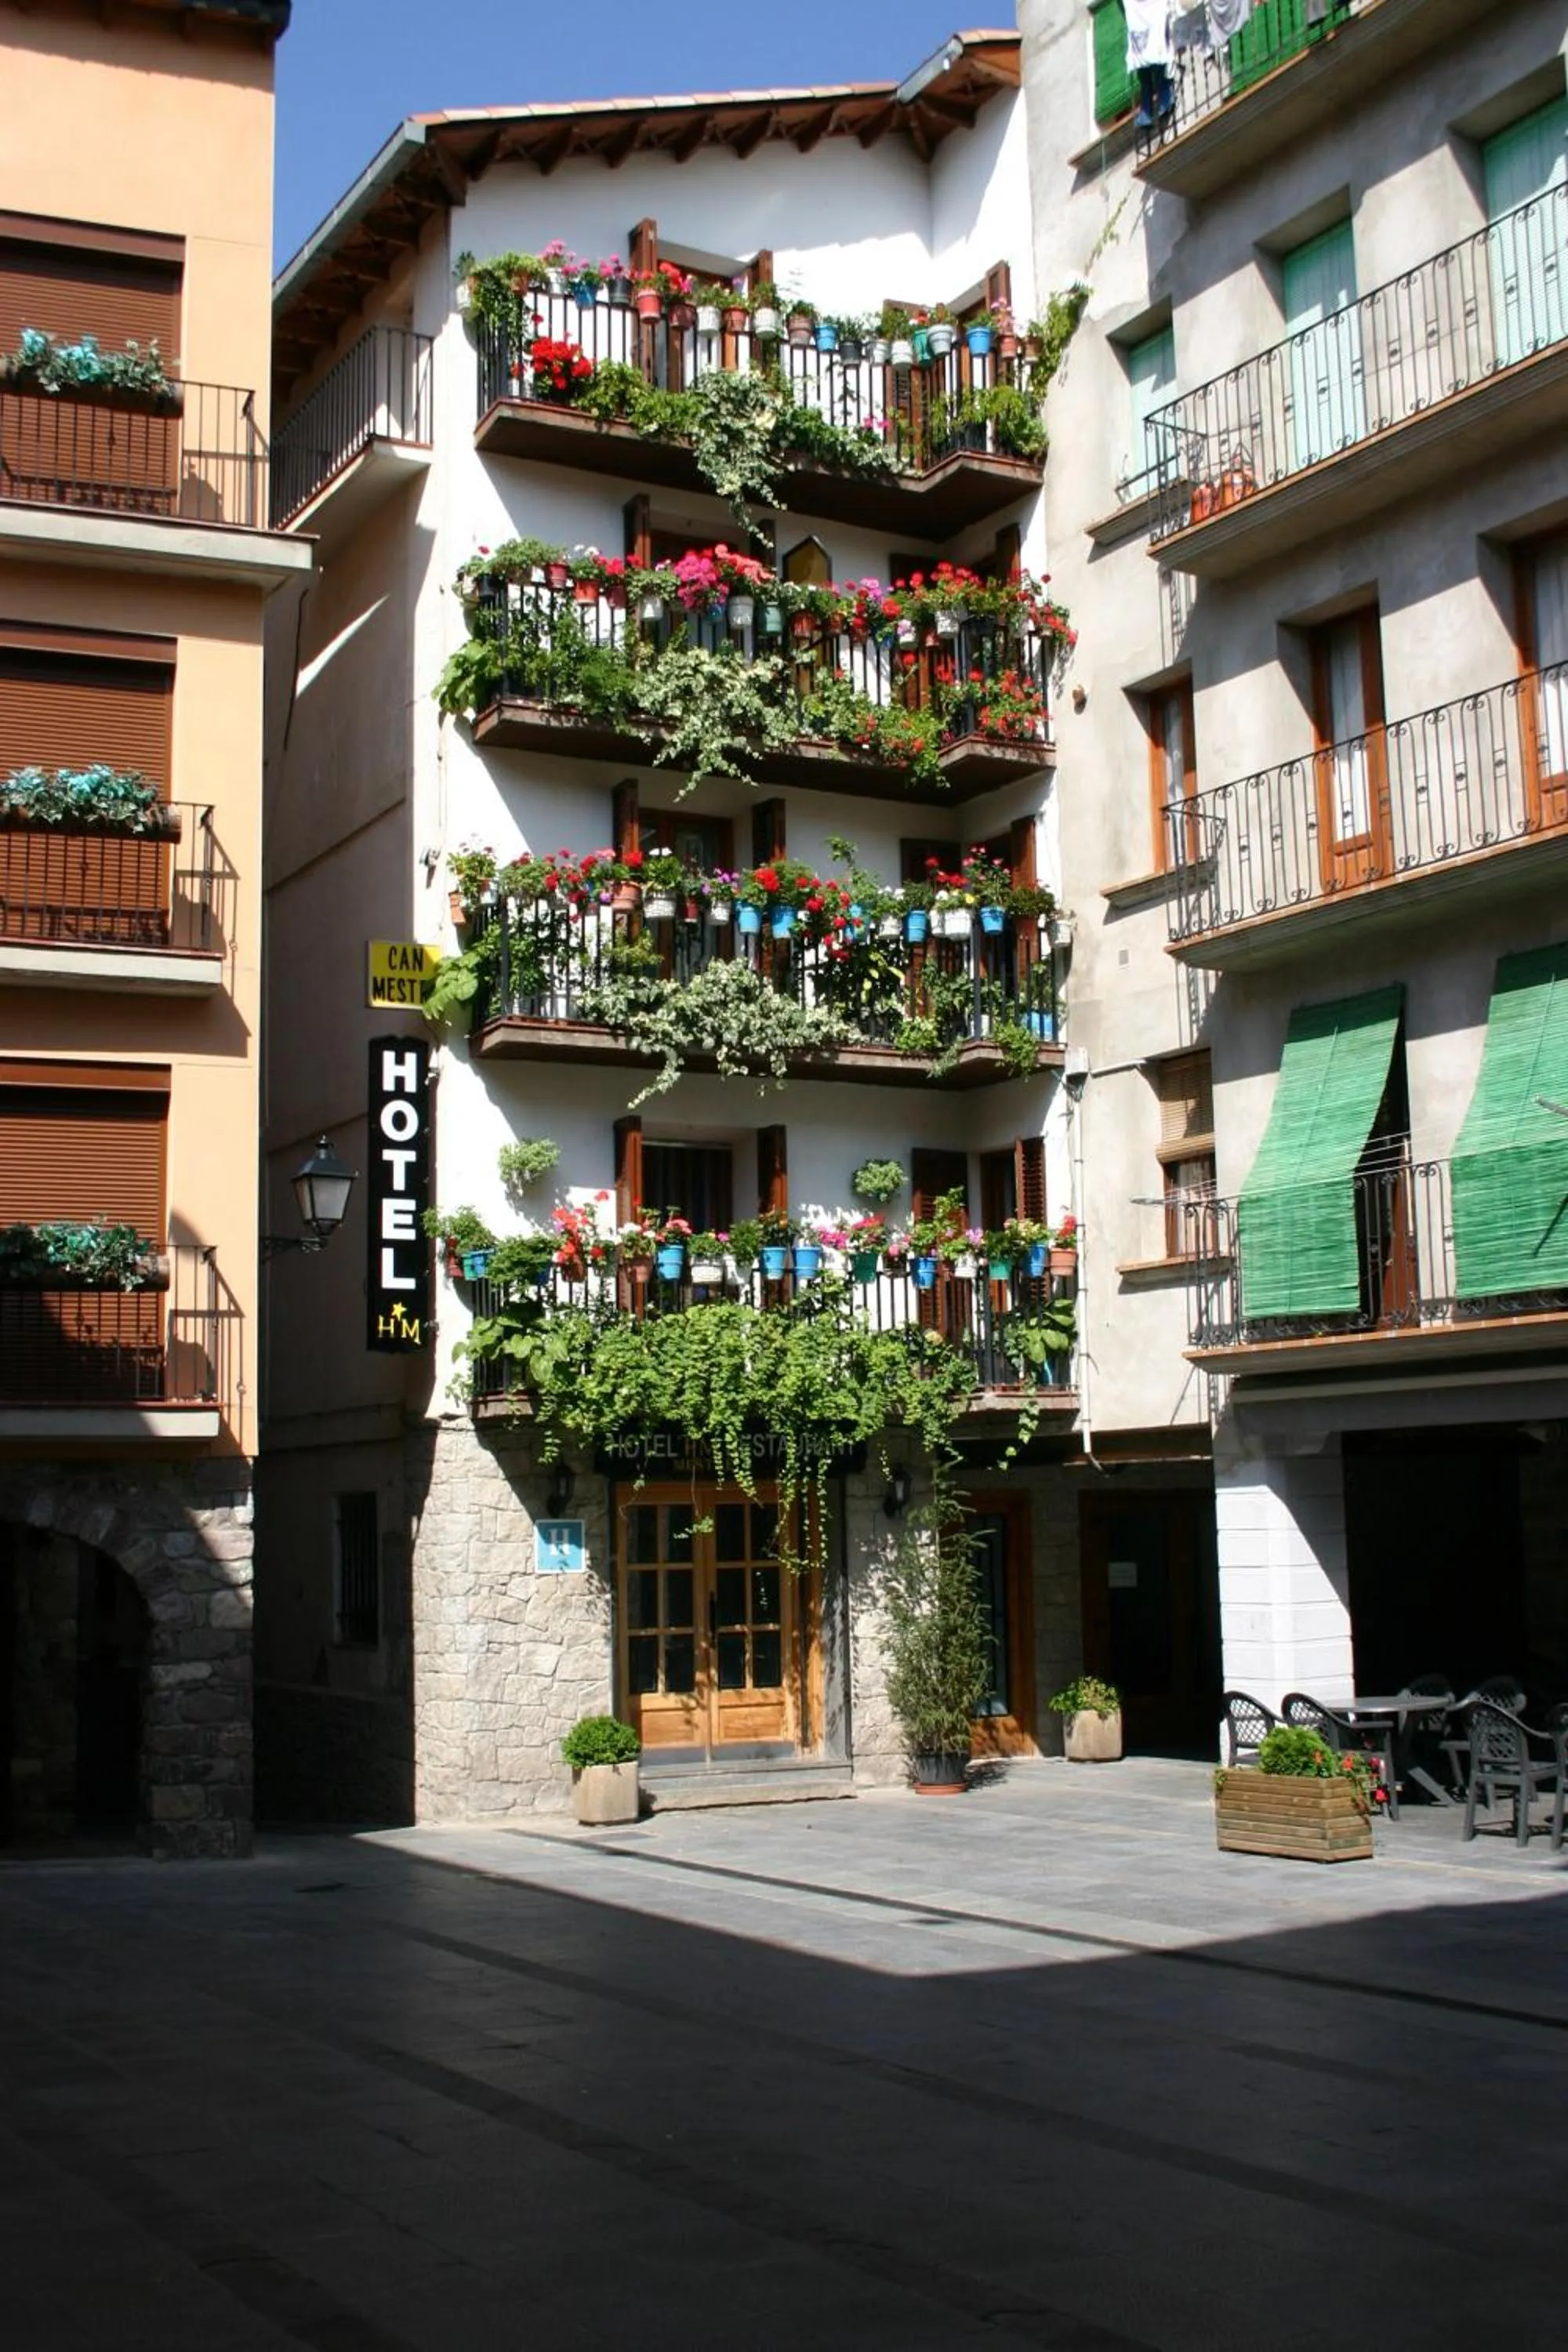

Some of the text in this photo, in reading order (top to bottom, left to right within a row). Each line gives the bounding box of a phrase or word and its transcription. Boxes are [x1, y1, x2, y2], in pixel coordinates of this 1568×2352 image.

[388, 946, 424, 972] CAN
[372, 977, 430, 1004] MEST
[380, 1050, 419, 1290] HOTEL
[606, 1432, 679, 1459] HOTEL
[548, 1527, 572, 1557] H
